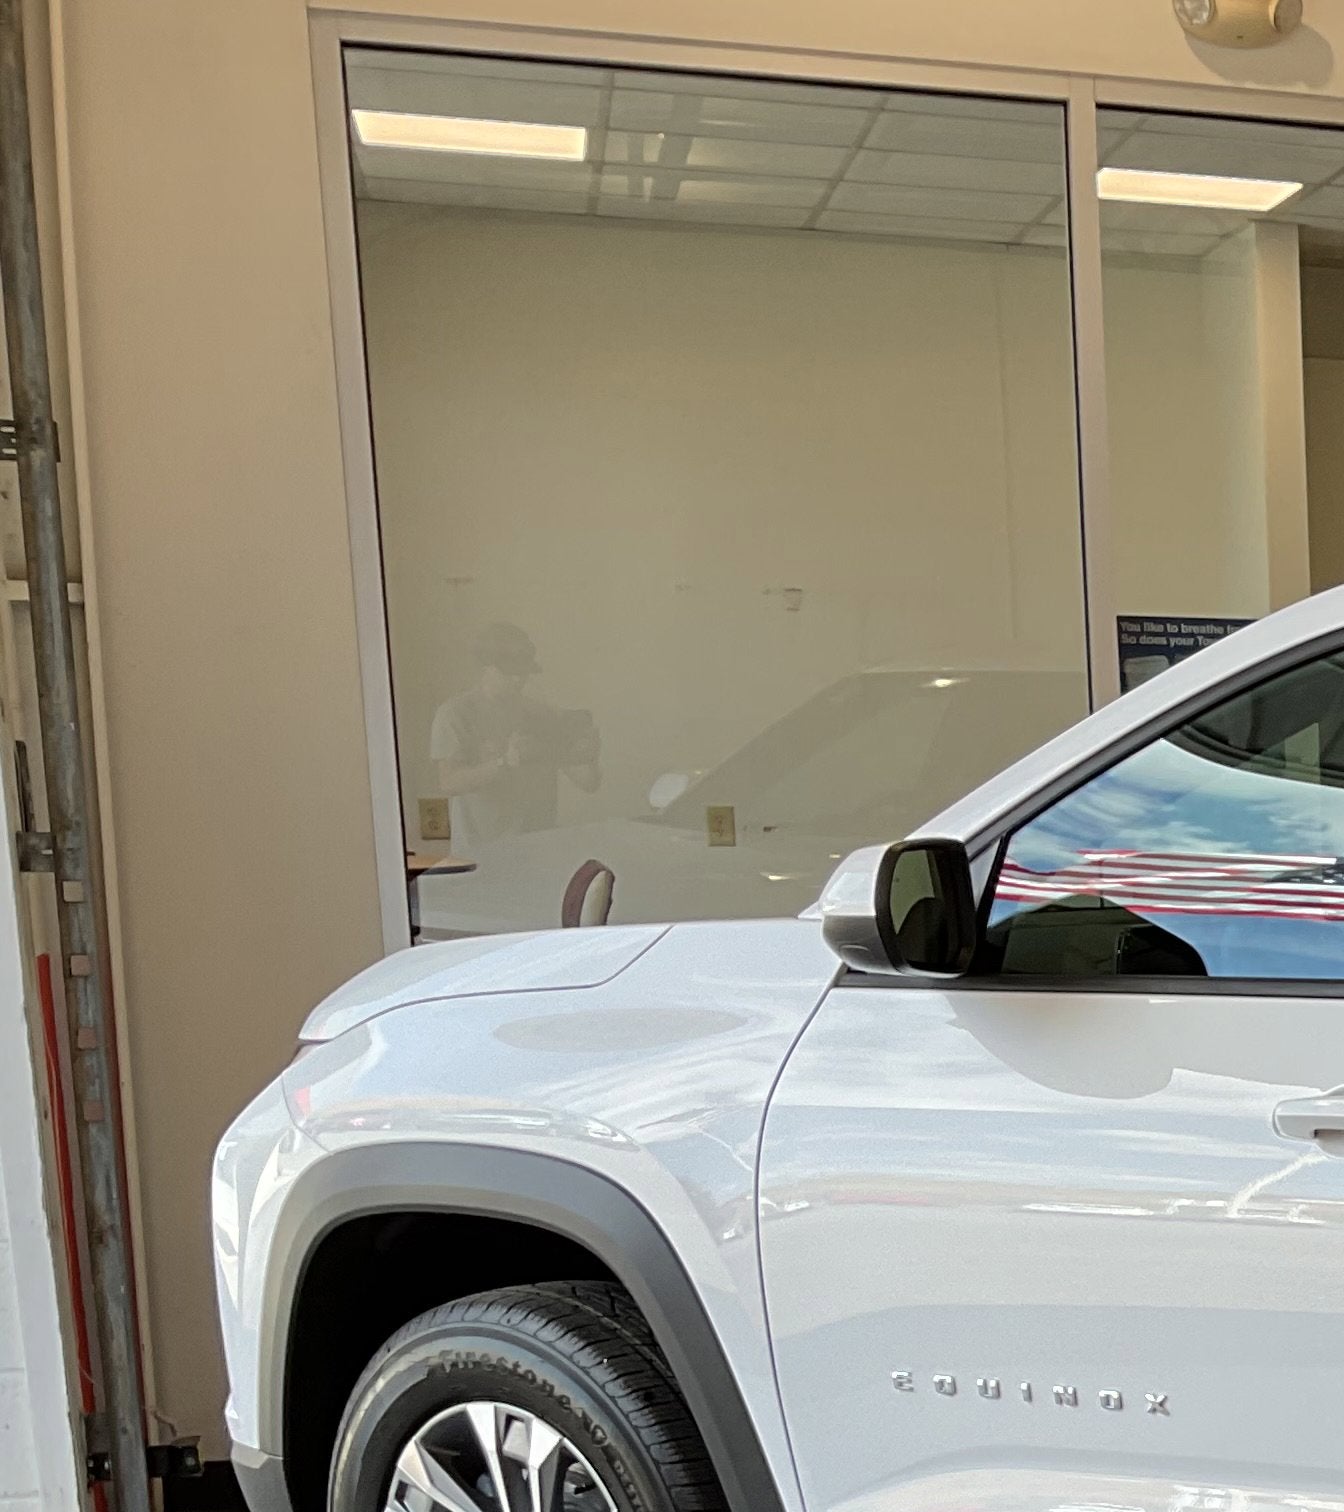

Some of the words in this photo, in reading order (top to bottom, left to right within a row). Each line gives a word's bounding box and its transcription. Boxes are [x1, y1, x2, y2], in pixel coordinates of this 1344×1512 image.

[1120, 621, 1141, 633] You
[1143, 622, 1164, 633] like
[1166, 623, 1179, 634] to
[1181, 623, 1225, 635] breathe
[1121, 633, 1137, 644] So
[1138, 634, 1168, 645] does
[1168, 635, 1195, 648] your
[890, 1369, 1171, 1417] EQUINOX
